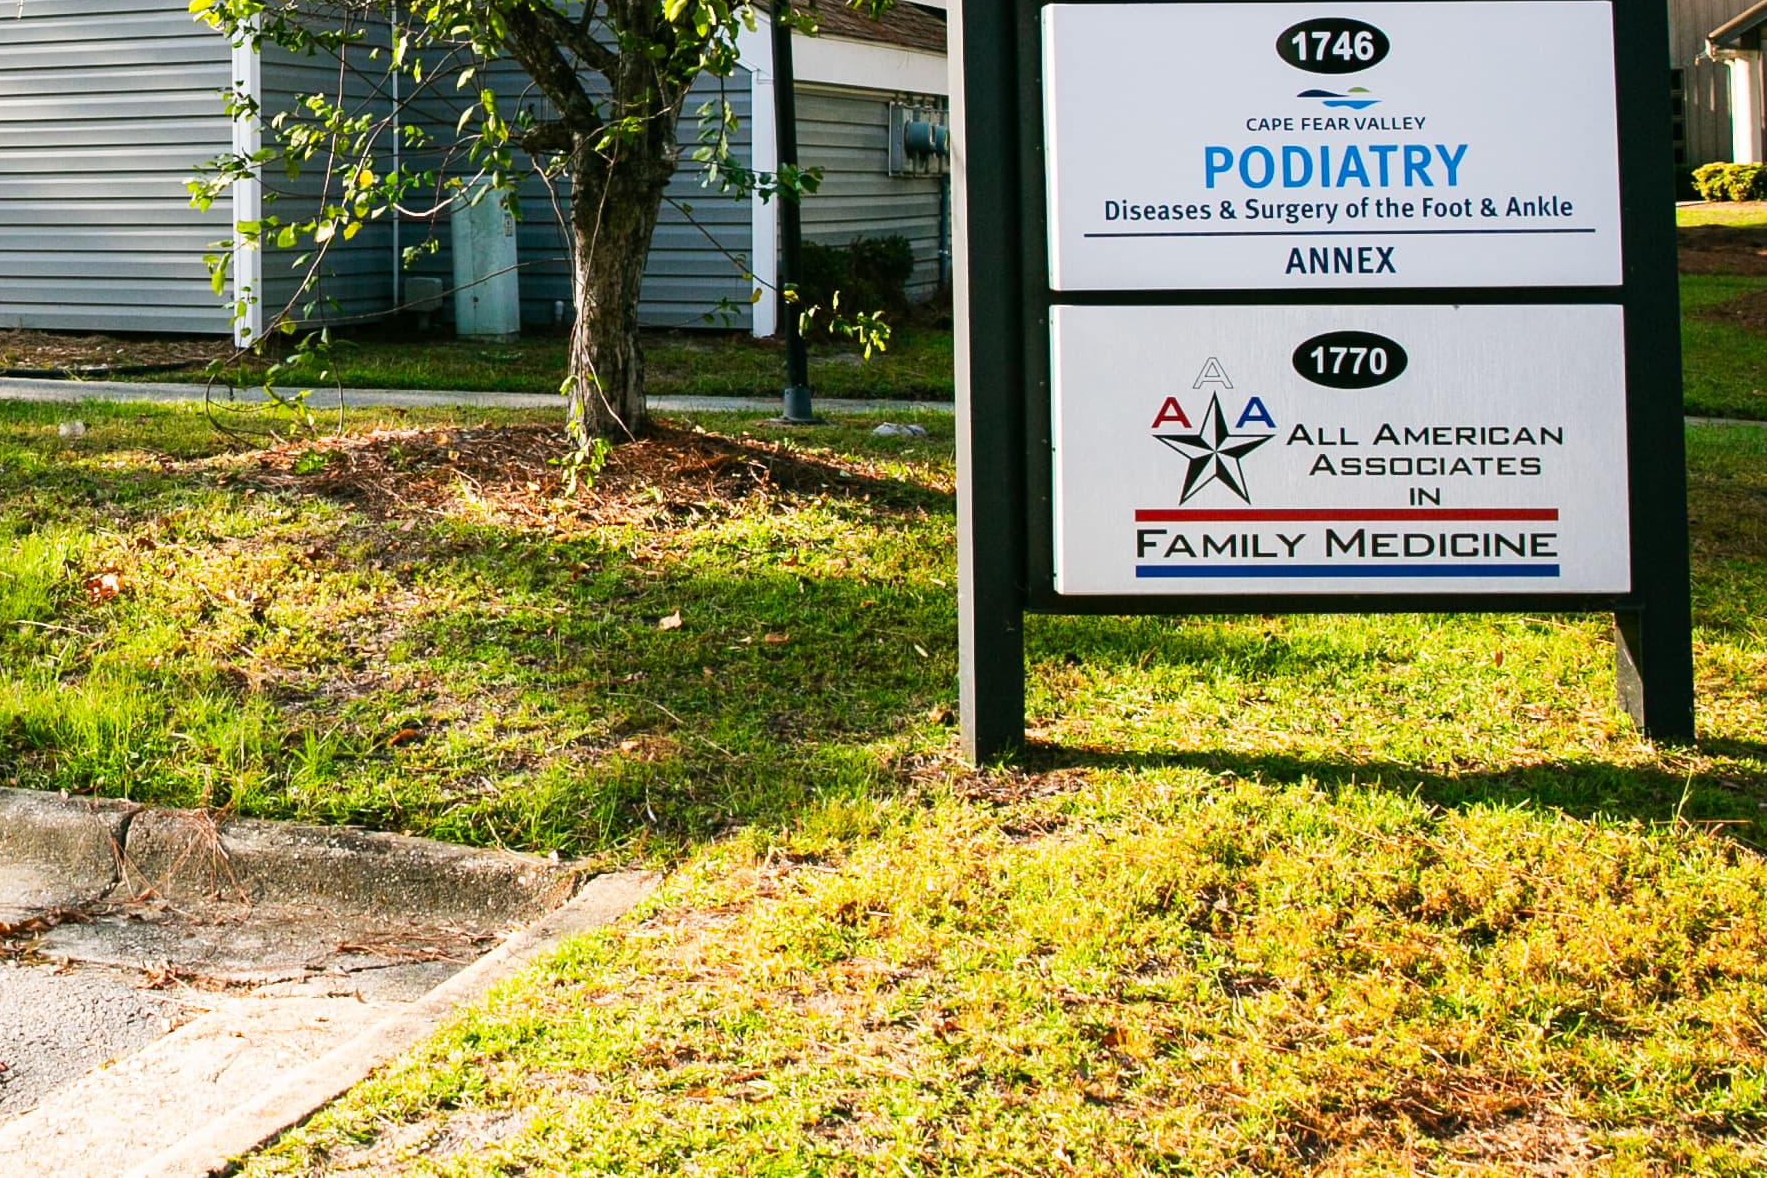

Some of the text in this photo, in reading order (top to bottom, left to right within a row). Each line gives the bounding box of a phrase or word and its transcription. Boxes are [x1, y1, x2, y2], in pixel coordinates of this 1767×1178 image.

[1292, 31, 1375, 61] 1746
[1247, 117, 1425, 131] CAPE FEAR VALLEY
[1205, 144, 1468, 189] PODIATRY
[1106, 196, 1572, 224] Diseases & Surgery of the Foot & Ankle
[1286, 247, 1396, 274] ANNEX
[1193, 357, 1233, 389] A
[1311, 346, 1387, 375] 1770
[1152, 397, 1276, 428] A A
[1286, 424, 1563, 445] ALL AMERICAN
[1309, 454, 1541, 475] ASSOCIATES
[1410, 487, 1441, 506] IN
[1137, 529, 1557, 558] FAMILY MEDICINE
